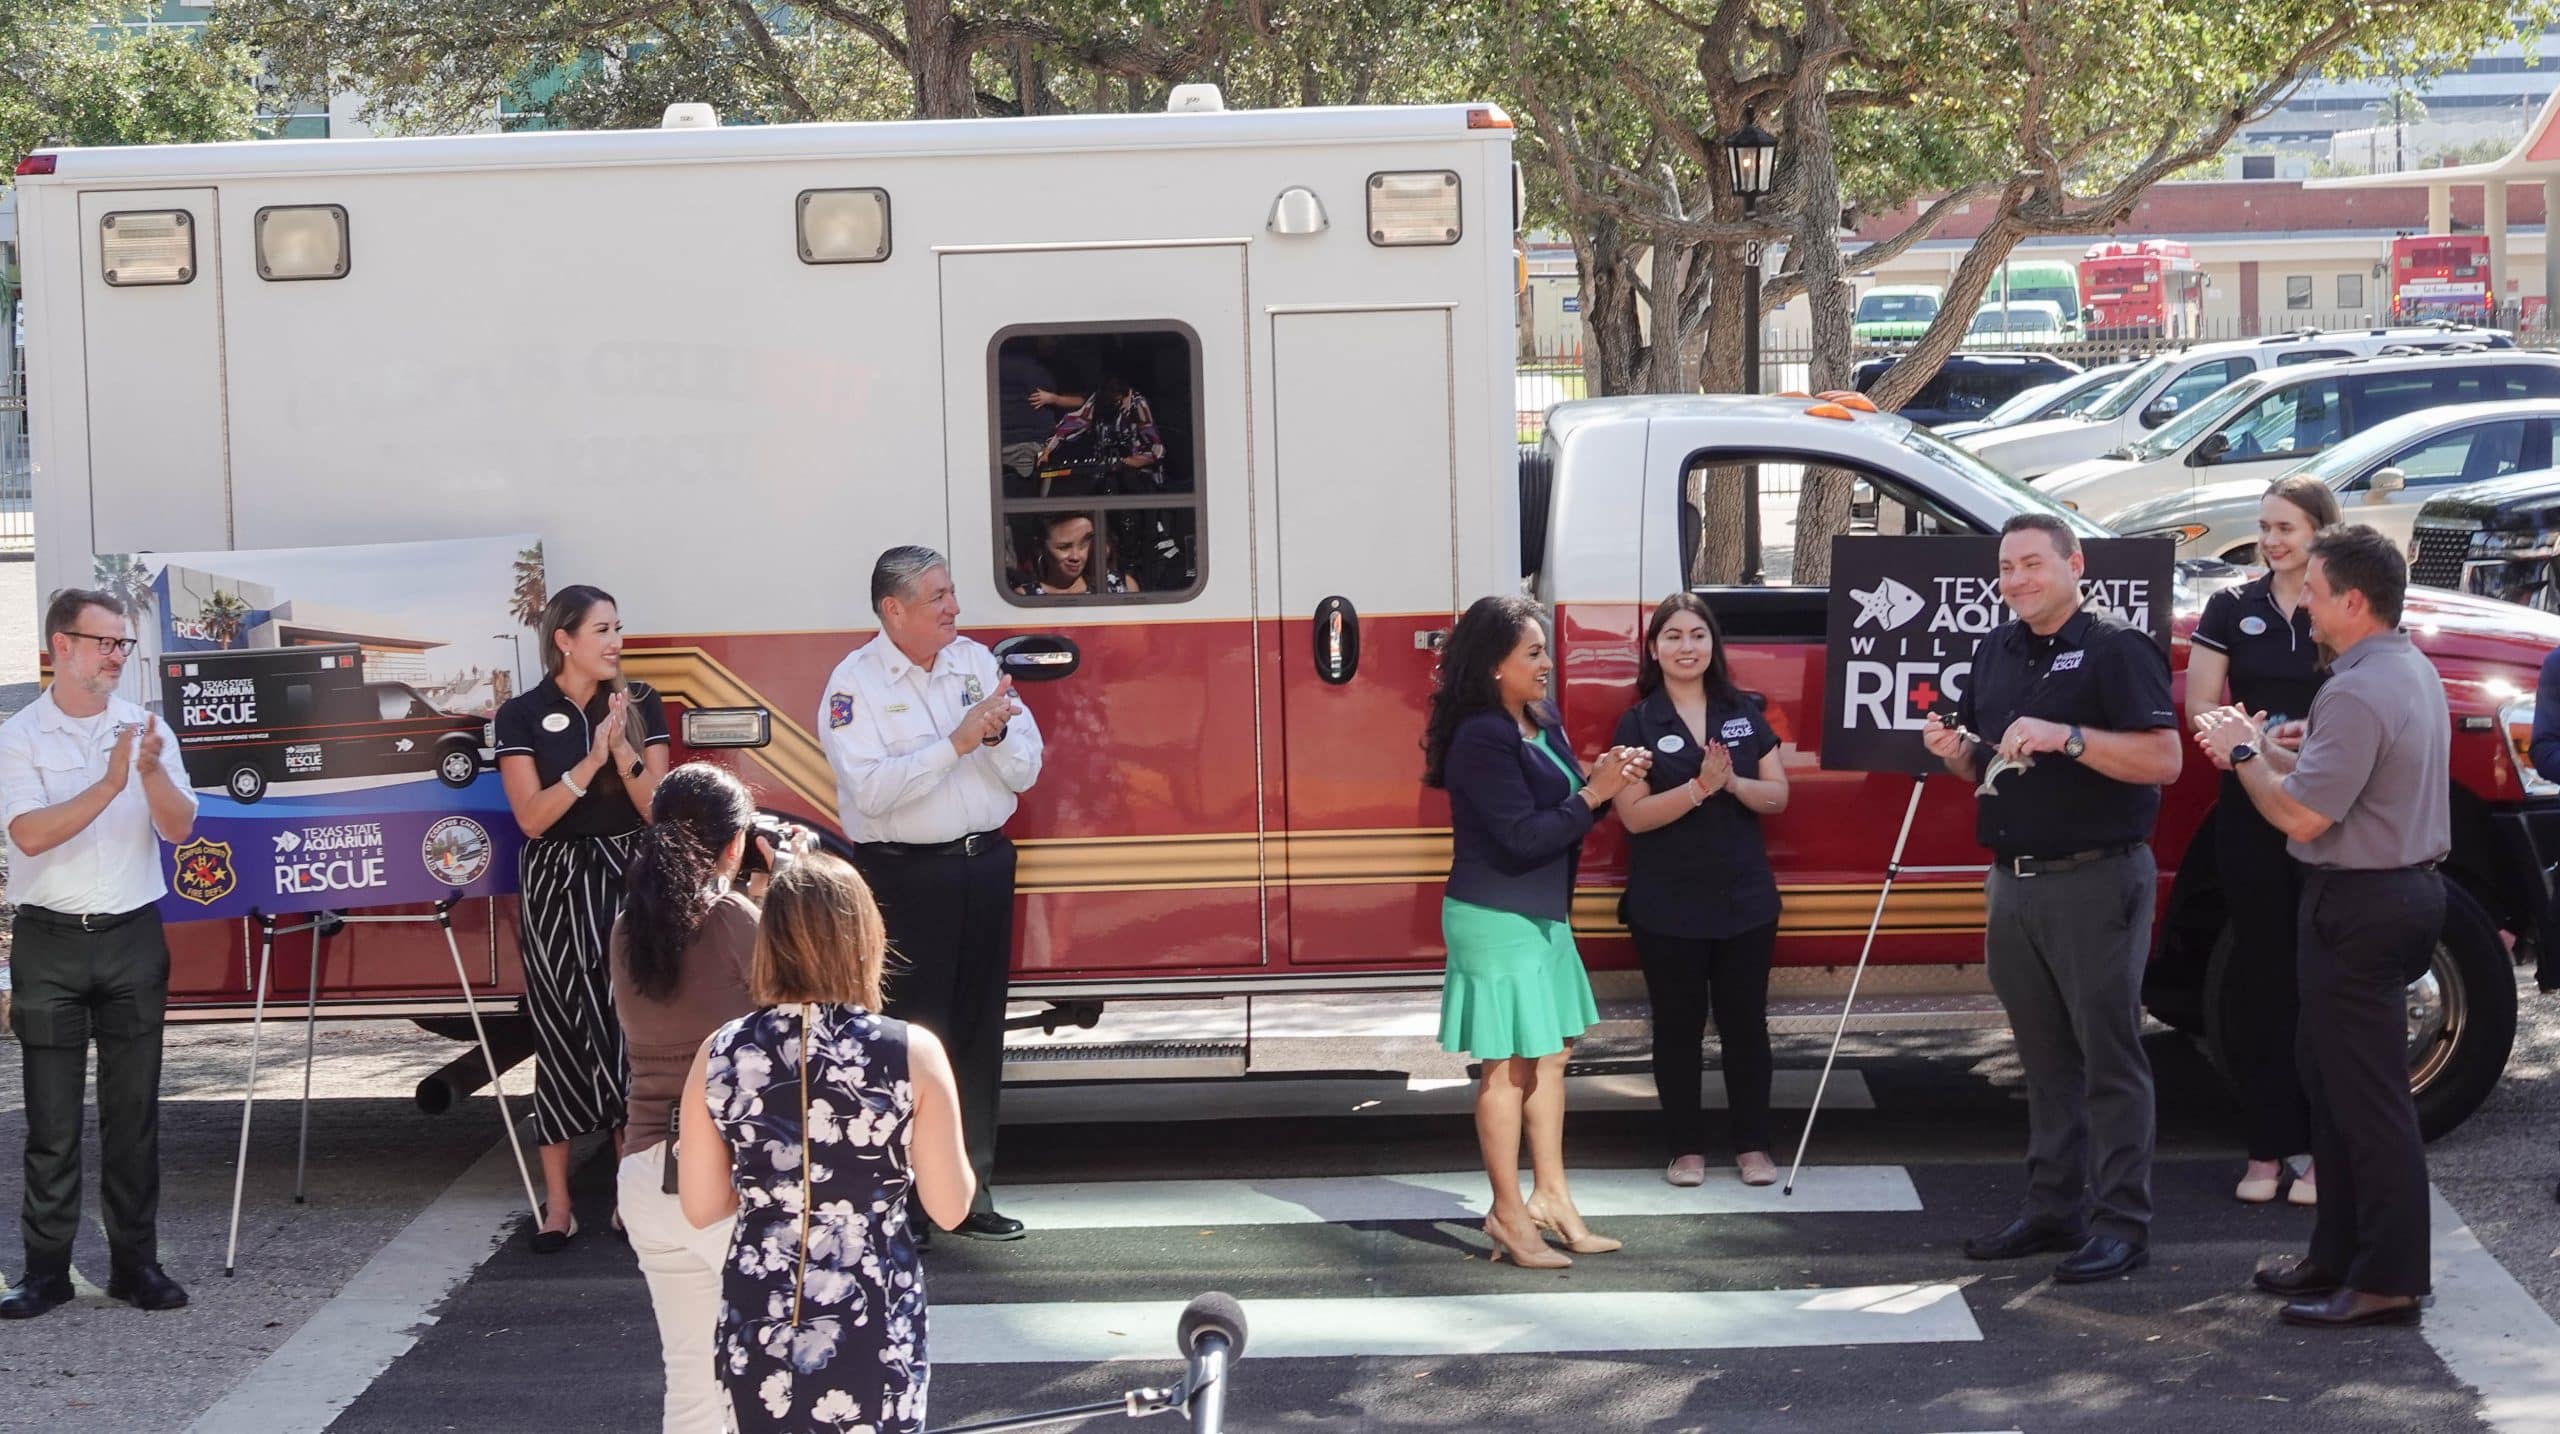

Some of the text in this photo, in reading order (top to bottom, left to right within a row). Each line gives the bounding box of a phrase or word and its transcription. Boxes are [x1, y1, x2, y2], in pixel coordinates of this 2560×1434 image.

[1747, 241, 1759, 265] 8
[1933, 577, 2004, 604] TEX
[201, 678, 254, 690] TEXAS STATE
[201, 687, 255, 697] AQUARIUM
[183, 696, 255, 704] WILDLIFE
[1843, 660, 1973, 731] RES
[183, 702, 258, 726] RESCUE
[302, 822, 381, 840] TEXAS STATE
[302, 832, 383, 852] AQUARIUM
[274, 847, 385, 864] WILDLIFE
[274, 857, 388, 895] RESCUE
